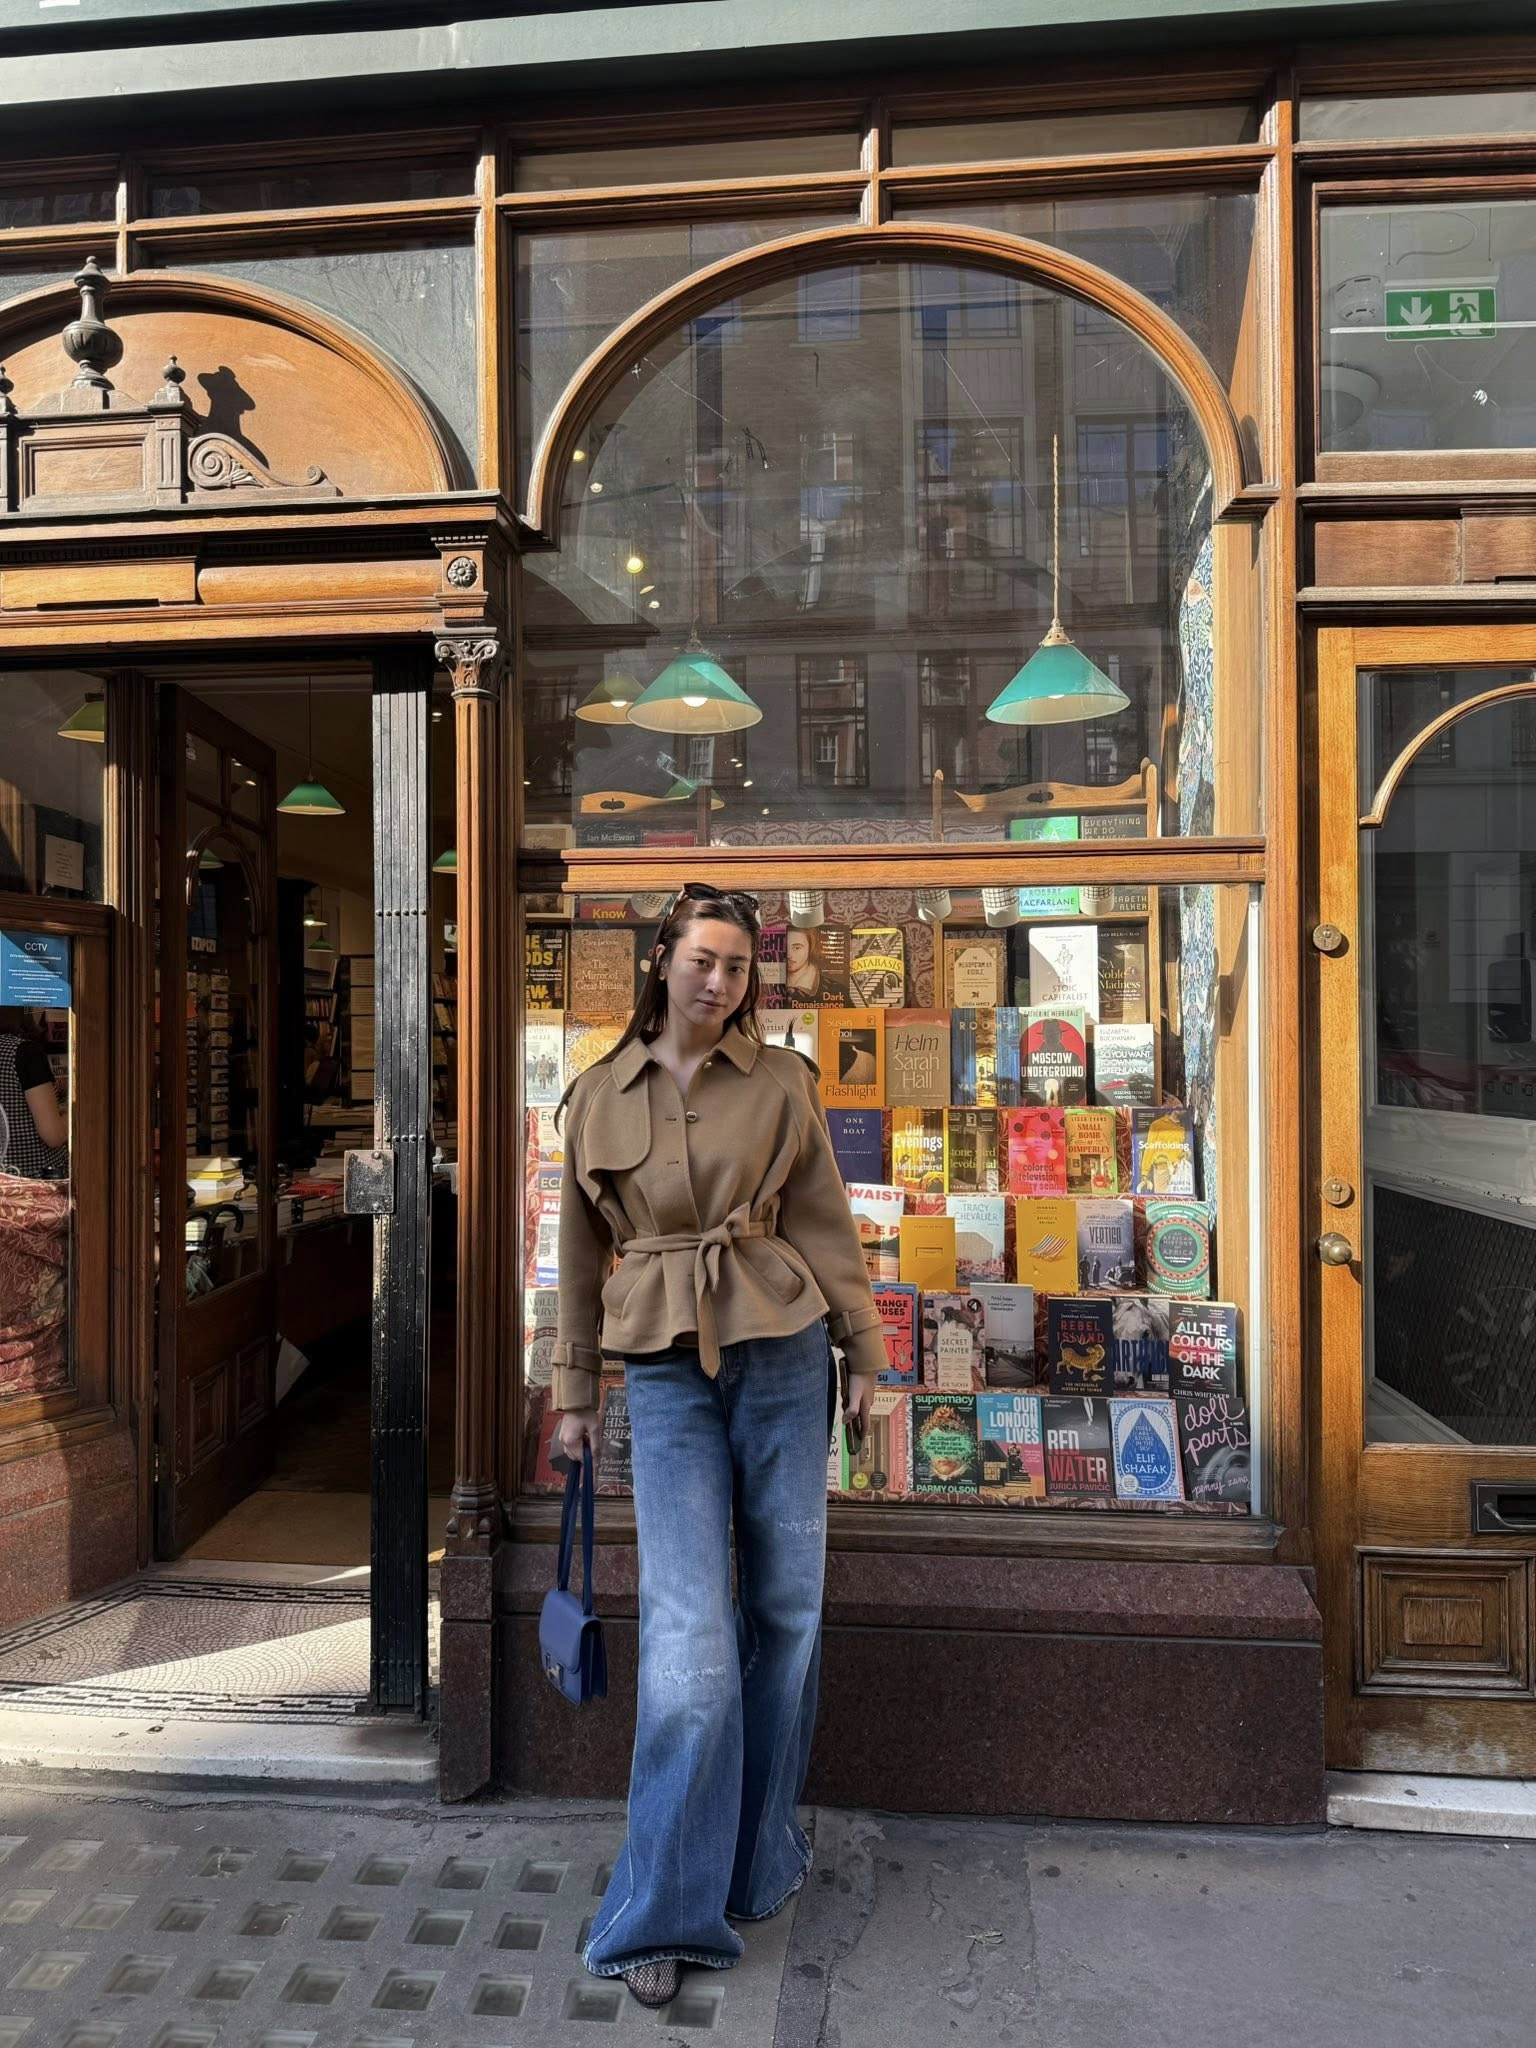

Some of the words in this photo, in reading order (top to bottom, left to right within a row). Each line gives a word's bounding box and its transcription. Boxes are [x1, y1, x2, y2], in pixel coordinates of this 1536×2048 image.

[1084, 817, 1140, 827] EVERYTHING
[1102, 826, 1115, 834] DO
[601, 833, 636, 841] McEwan
[1114, 896, 1146, 904] ZABETH
[592, 908, 627, 919] Know
[24, 942, 48, 952] CCTV
[592, 959, 608, 968] The
[582, 970, 608, 980] Mirror
[610, 970, 620, 980] of
[1098, 968, 1126, 980] Noble
[576, 980, 598, 990] Great
[599, 980, 624, 990] Britain
[1056, 976, 1073, 984] THE
[1100, 980, 1140, 990] Madness
[1052, 984, 1078, 992] STOIC
[822, 992, 844, 1000] Dark
[1042, 993, 1088, 1002] CAPITALIST
[792, 1000, 844, 1009] Renaissance
[1024, 1010, 1050, 1018] CATHERINE
[760, 1024, 784, 1032] Artist
[826, 1019, 852, 1027] Susan
[832, 1028, 852, 1038] Choi
[895, 1034, 939, 1052] Helm
[1032, 1052, 1072, 1064] MOSCOW
[1112, 1050, 1128, 1058] YOU
[1128, 1050, 1150, 1058] WANT
[894, 1052, 940, 1071] Sarah
[1021, 1065, 1084, 1078] UNDERGROUND
[902, 1071, 932, 1089] Hall
[825, 1085, 876, 1099] Flashlight
[905, 1120, 924, 1134] Our
[1078, 1132, 1100, 1140] BOMB
[894, 1136, 943, 1152] Evenings
[1138, 1140, 1190, 1151] Scaffolding
[917, 1154, 936, 1162] Alan
[896, 1162, 943, 1172] Hollinghurst
[1022, 1164, 1054, 1172] colored
[1019, 1172, 1058, 1182] television
[541, 1177, 562, 1188] EC
[848, 1188, 903, 1202] WAIST
[962, 1203, 990, 1212] TRACY
[955, 1212, 998, 1222] CHEVALIER
[860, 1223, 900, 1236] EEP
[1089, 1226, 1122, 1244] VERTIGO
[874, 1300, 908, 1308] RANGE
[1061, 1320, 1100, 1330] REBEL
[1176, 1321, 1200, 1335] ALL
[1200, 1322, 1228, 1337] THE
[942, 1338, 967, 1346] SECRET
[1057, 1332, 1104, 1343] ISLAND
[1171, 1334, 1232, 1351] COLOURS
[940, 1346, 970, 1354] PAINTER
[1180, 1351, 1197, 1364] OF
[1198, 1352, 1225, 1367] THE
[1182, 1364, 1220, 1380] DARK
[1173, 1388, 1193, 1396] CHRIS
[1194, 1391, 1230, 1399] WHITAKER
[915, 1395, 975, 1404] supremacy
[1013, 1397, 1038, 1412] OUR
[1185, 1396, 1245, 1431] doll
[605, 1418, 626, 1428] HIS
[990, 1412, 1038, 1428] LONDON
[1006, 1428, 1039, 1444] LIVES
[1047, 1430, 1080, 1453] RED
[1185, 1422, 1250, 1466] parts
[1136, 1453, 1156, 1462] ELIF
[1048, 1456, 1108, 1483] WATER
[1125, 1464, 1168, 1474] SHAFAK
[917, 1485, 946, 1493] PARMY
[948, 1485, 977, 1494] OLSON
[1192, 1480, 1226, 1497] penny
